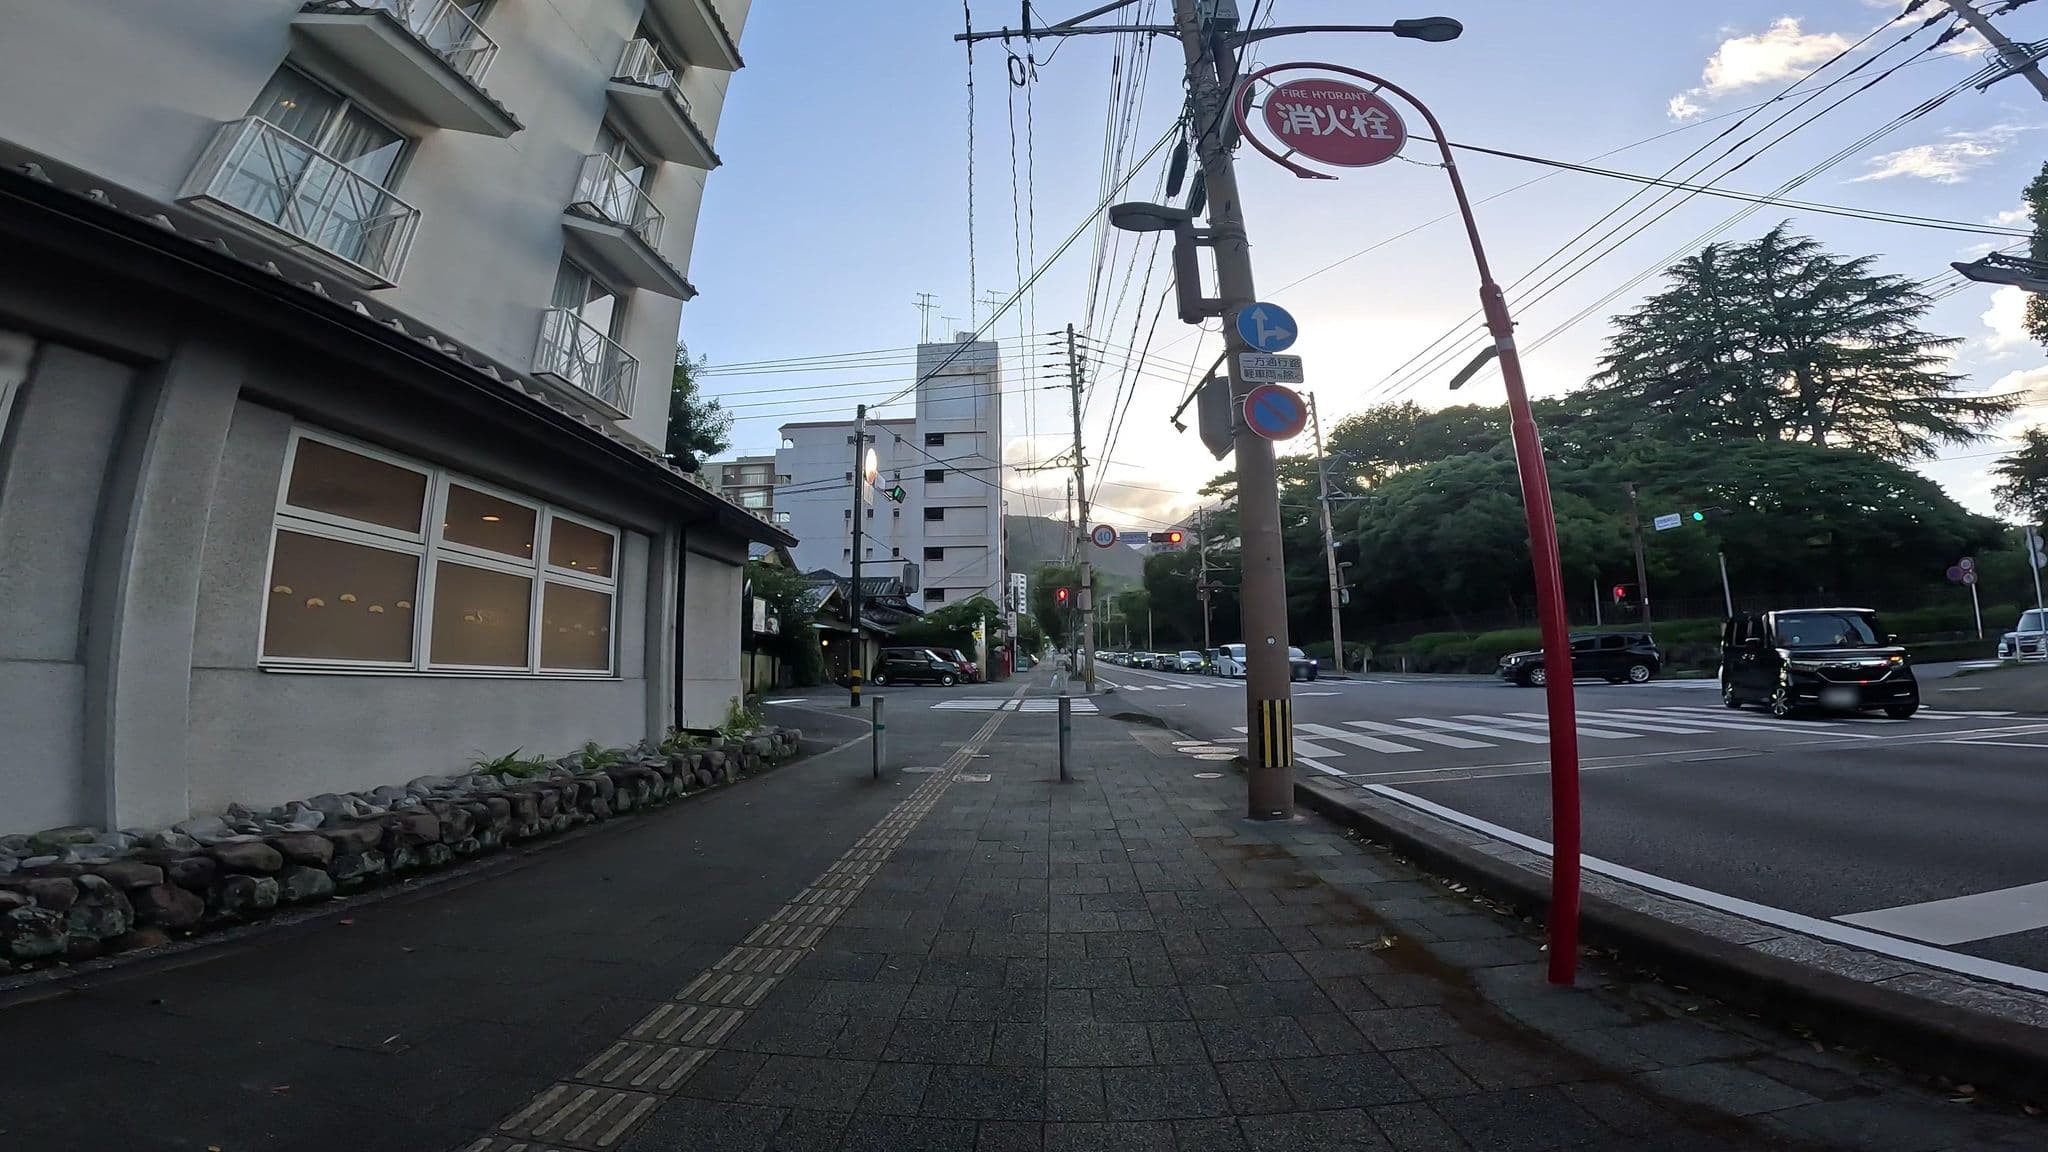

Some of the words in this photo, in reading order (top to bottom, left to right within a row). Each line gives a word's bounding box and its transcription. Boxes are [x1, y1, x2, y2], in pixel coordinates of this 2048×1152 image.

[1281, 89, 1308, 99] FIRE
[1311, 90, 1368, 101] HYDRANT
[1275, 102, 1395, 139] 消火栓
[1097, 531, 1111, 542] 40
